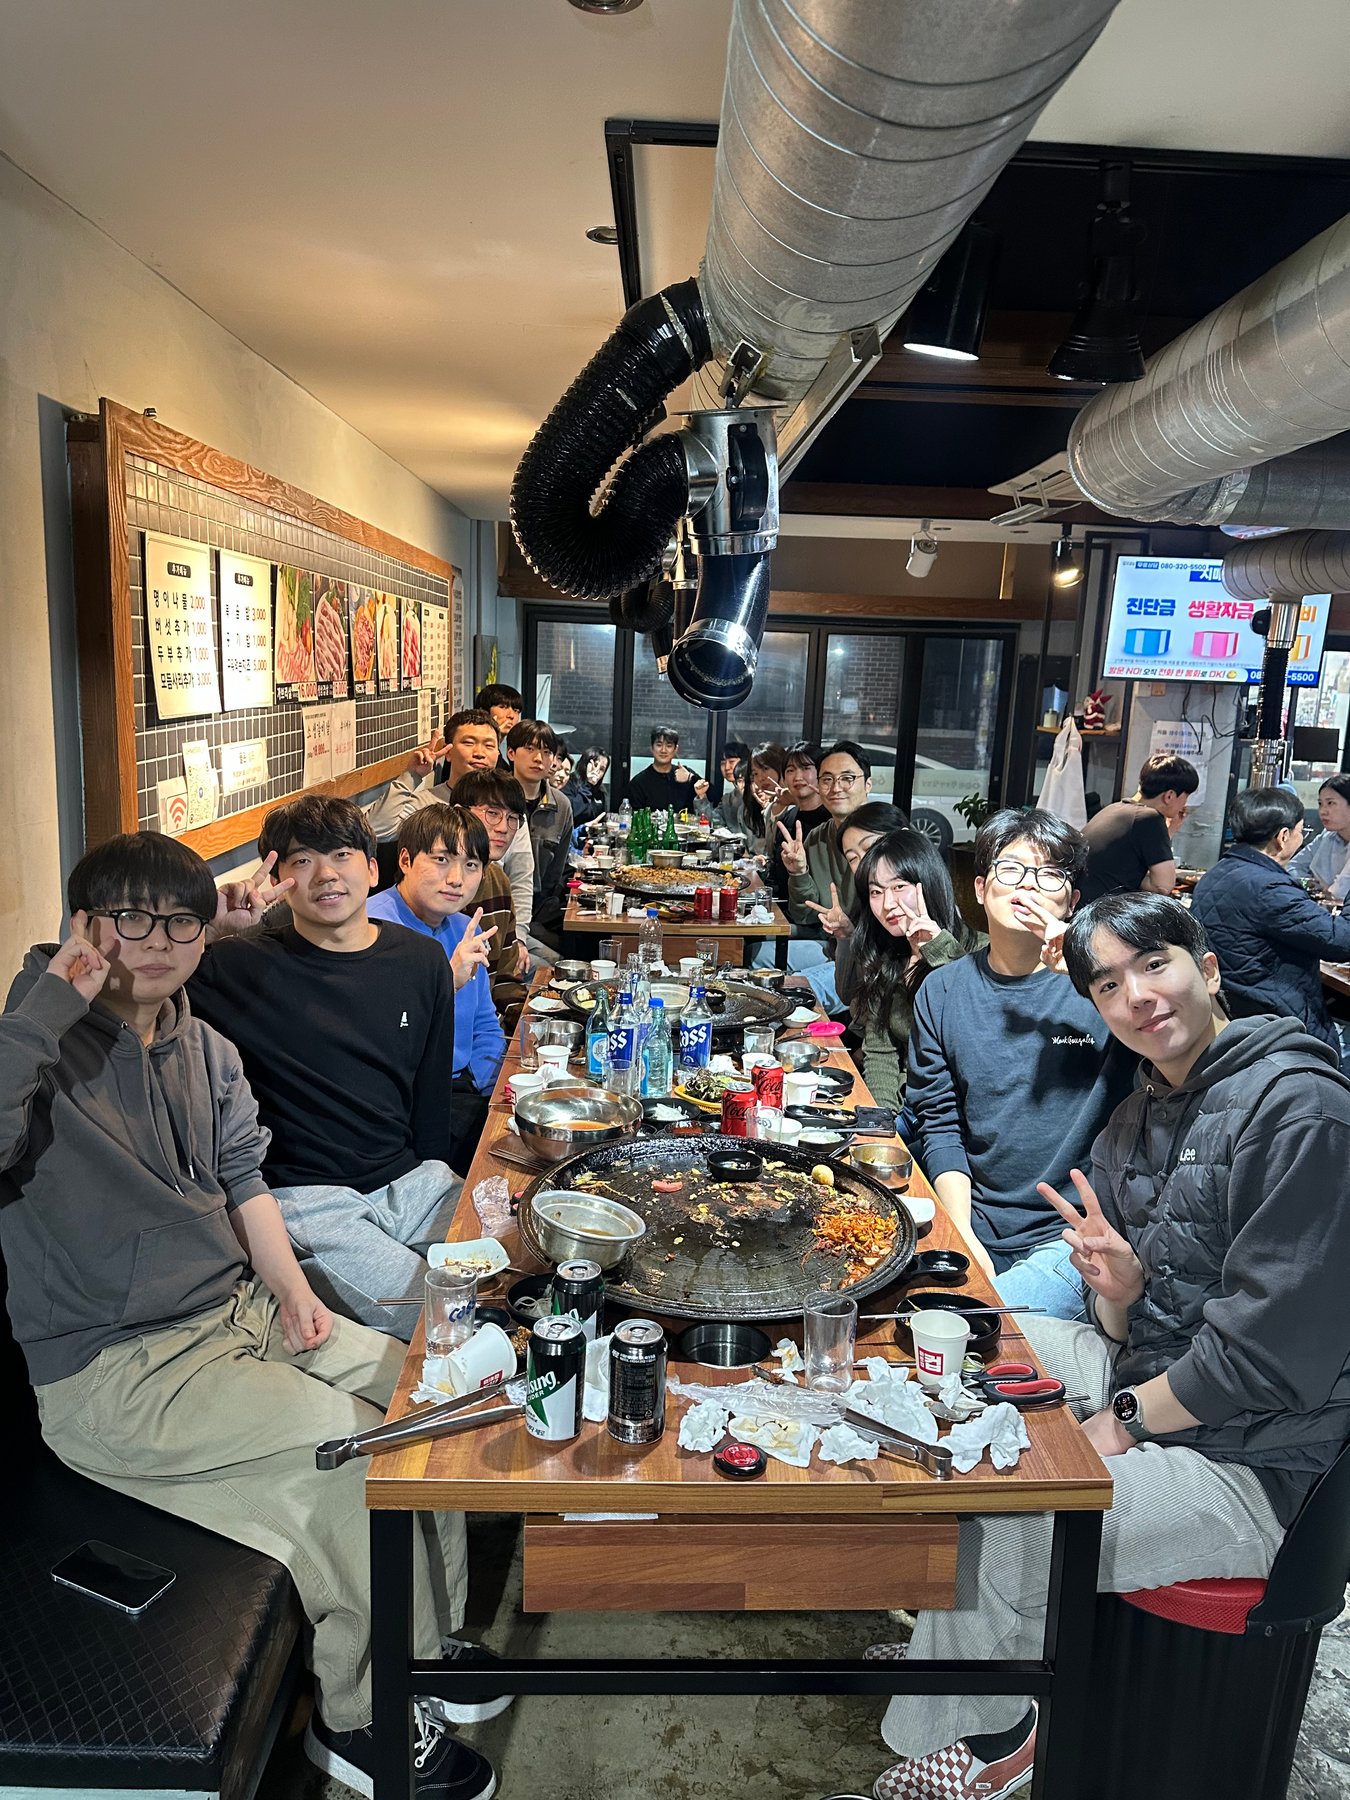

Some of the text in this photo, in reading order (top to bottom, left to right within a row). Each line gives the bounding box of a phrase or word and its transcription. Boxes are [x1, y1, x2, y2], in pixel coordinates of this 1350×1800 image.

[1160, 563, 1206, 571] 080-320-5500
[190, 595, 206, 610] 2,000
[1126, 597, 1176, 616] 진단금
[1188, 600, 1254, 619] 생활자금
[252, 607, 266, 621] 3,000
[1300, 605, 1317, 622] 비
[1108, 666, 1125, 675] 방문
[1143, 668, 1157, 676] 오직
[1158, 668, 1174, 677] 전화
[1175, 669, 1184, 677] 한
[610, 1030, 628, 1051] ss
[1180, 1148, 1196, 1161] Lee
